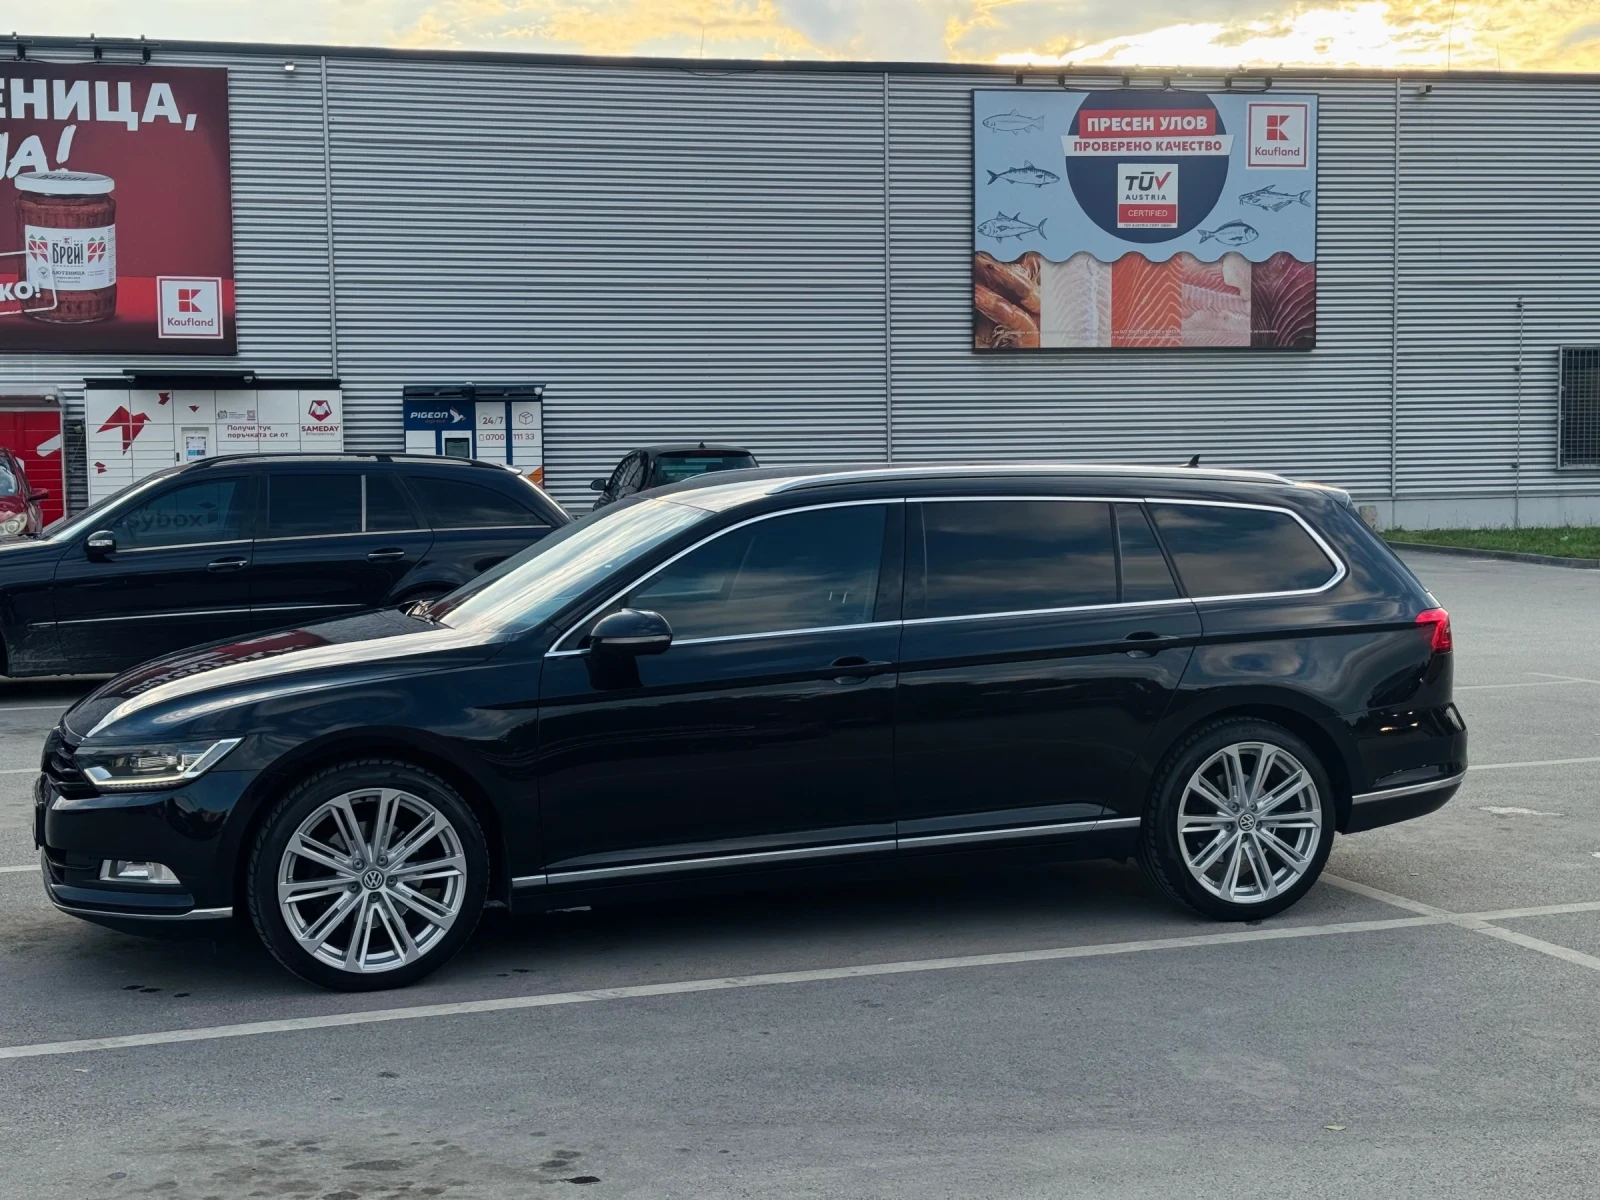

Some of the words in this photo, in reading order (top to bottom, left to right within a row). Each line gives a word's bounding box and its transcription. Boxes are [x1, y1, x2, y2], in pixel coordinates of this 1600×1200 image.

[0, 77, 197, 131] НИЦА,
[1087, 116, 1154, 132] ПРЕСЕН
[1159, 115, 1208, 131] УЛОВ
[1073, 141, 1152, 152] ПРОВЕРЕНО
[1156, 140, 1222, 152] КАЧЕСТВО
[1255, 146, 1300, 156] Kaufland
[1127, 209, 1168, 217] CERTIFIED
[167, 317, 214, 326] Kaufland
[410, 411, 448, 419] PIGEON
[482, 416, 504, 425] 24/7
[227, 424, 256, 432] Получи
[485, 433, 505, 441] 0700
[524, 433, 535, 441] 33
